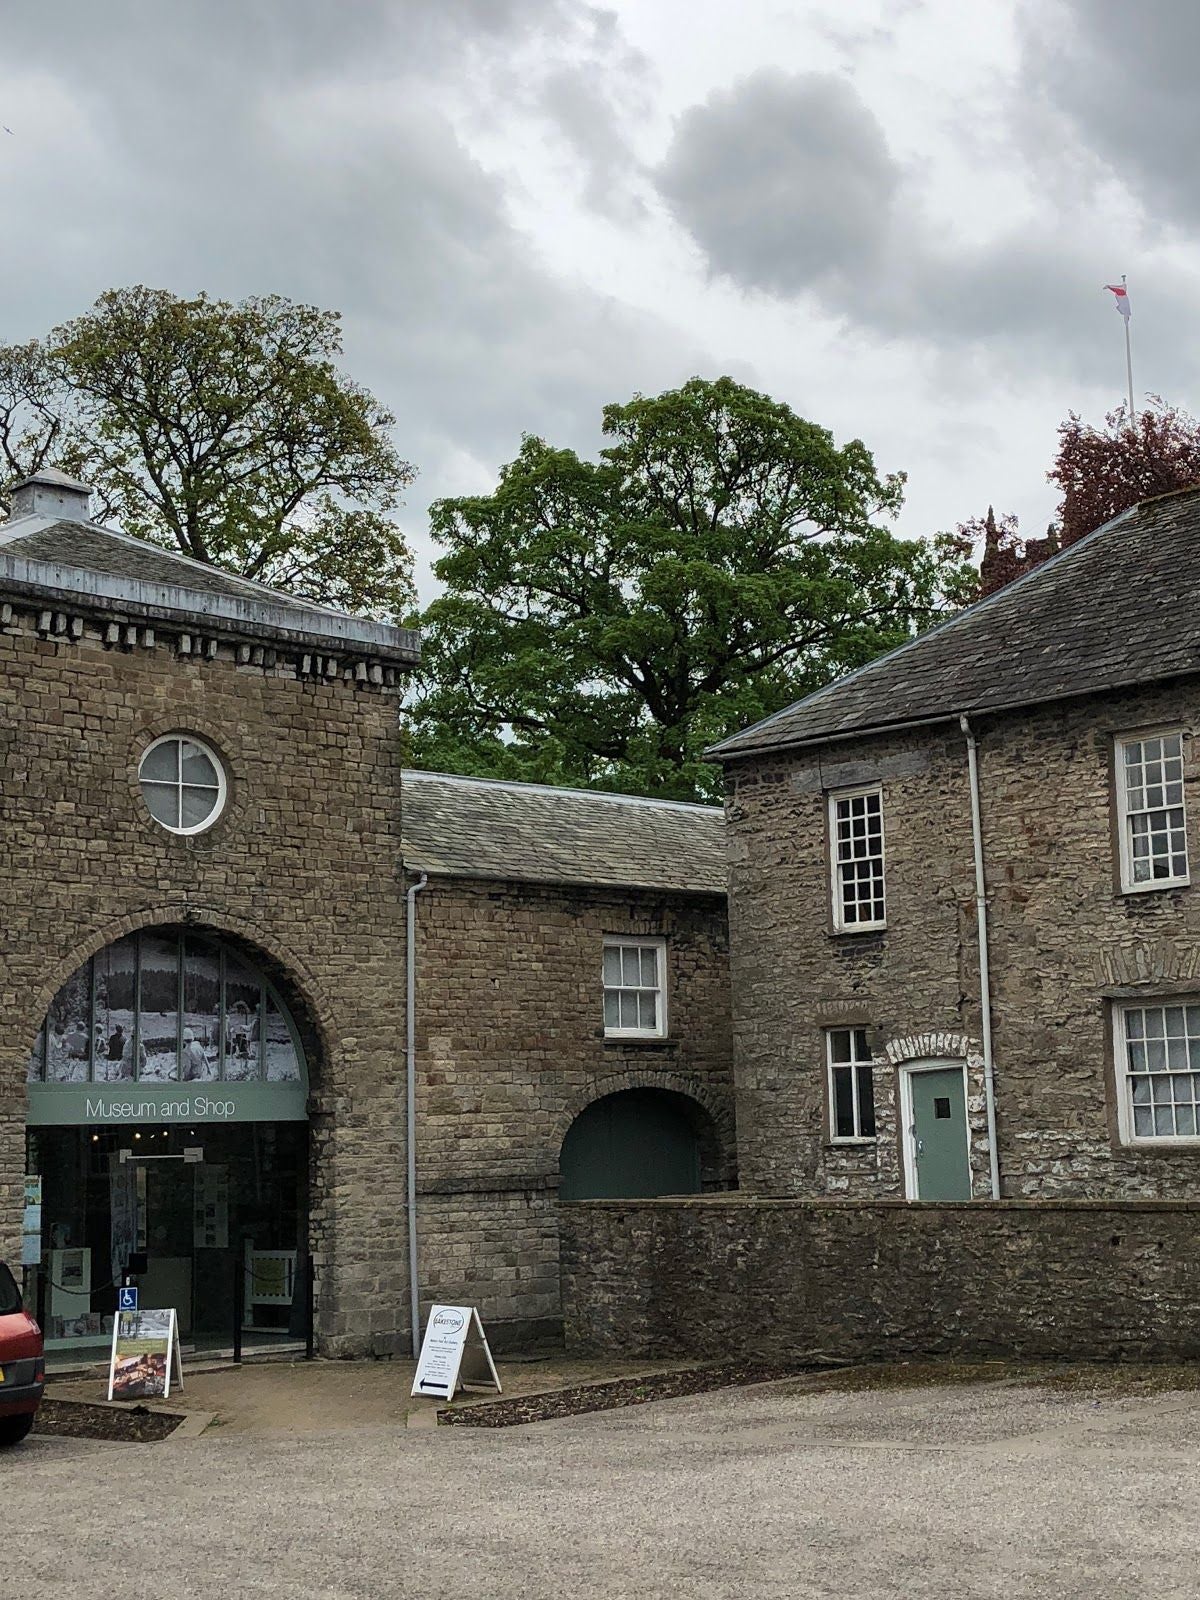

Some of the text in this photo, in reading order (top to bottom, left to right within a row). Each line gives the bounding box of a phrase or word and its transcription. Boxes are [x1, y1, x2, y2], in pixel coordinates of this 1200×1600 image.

[86, 1097, 235, 1118] Museum and Shop
